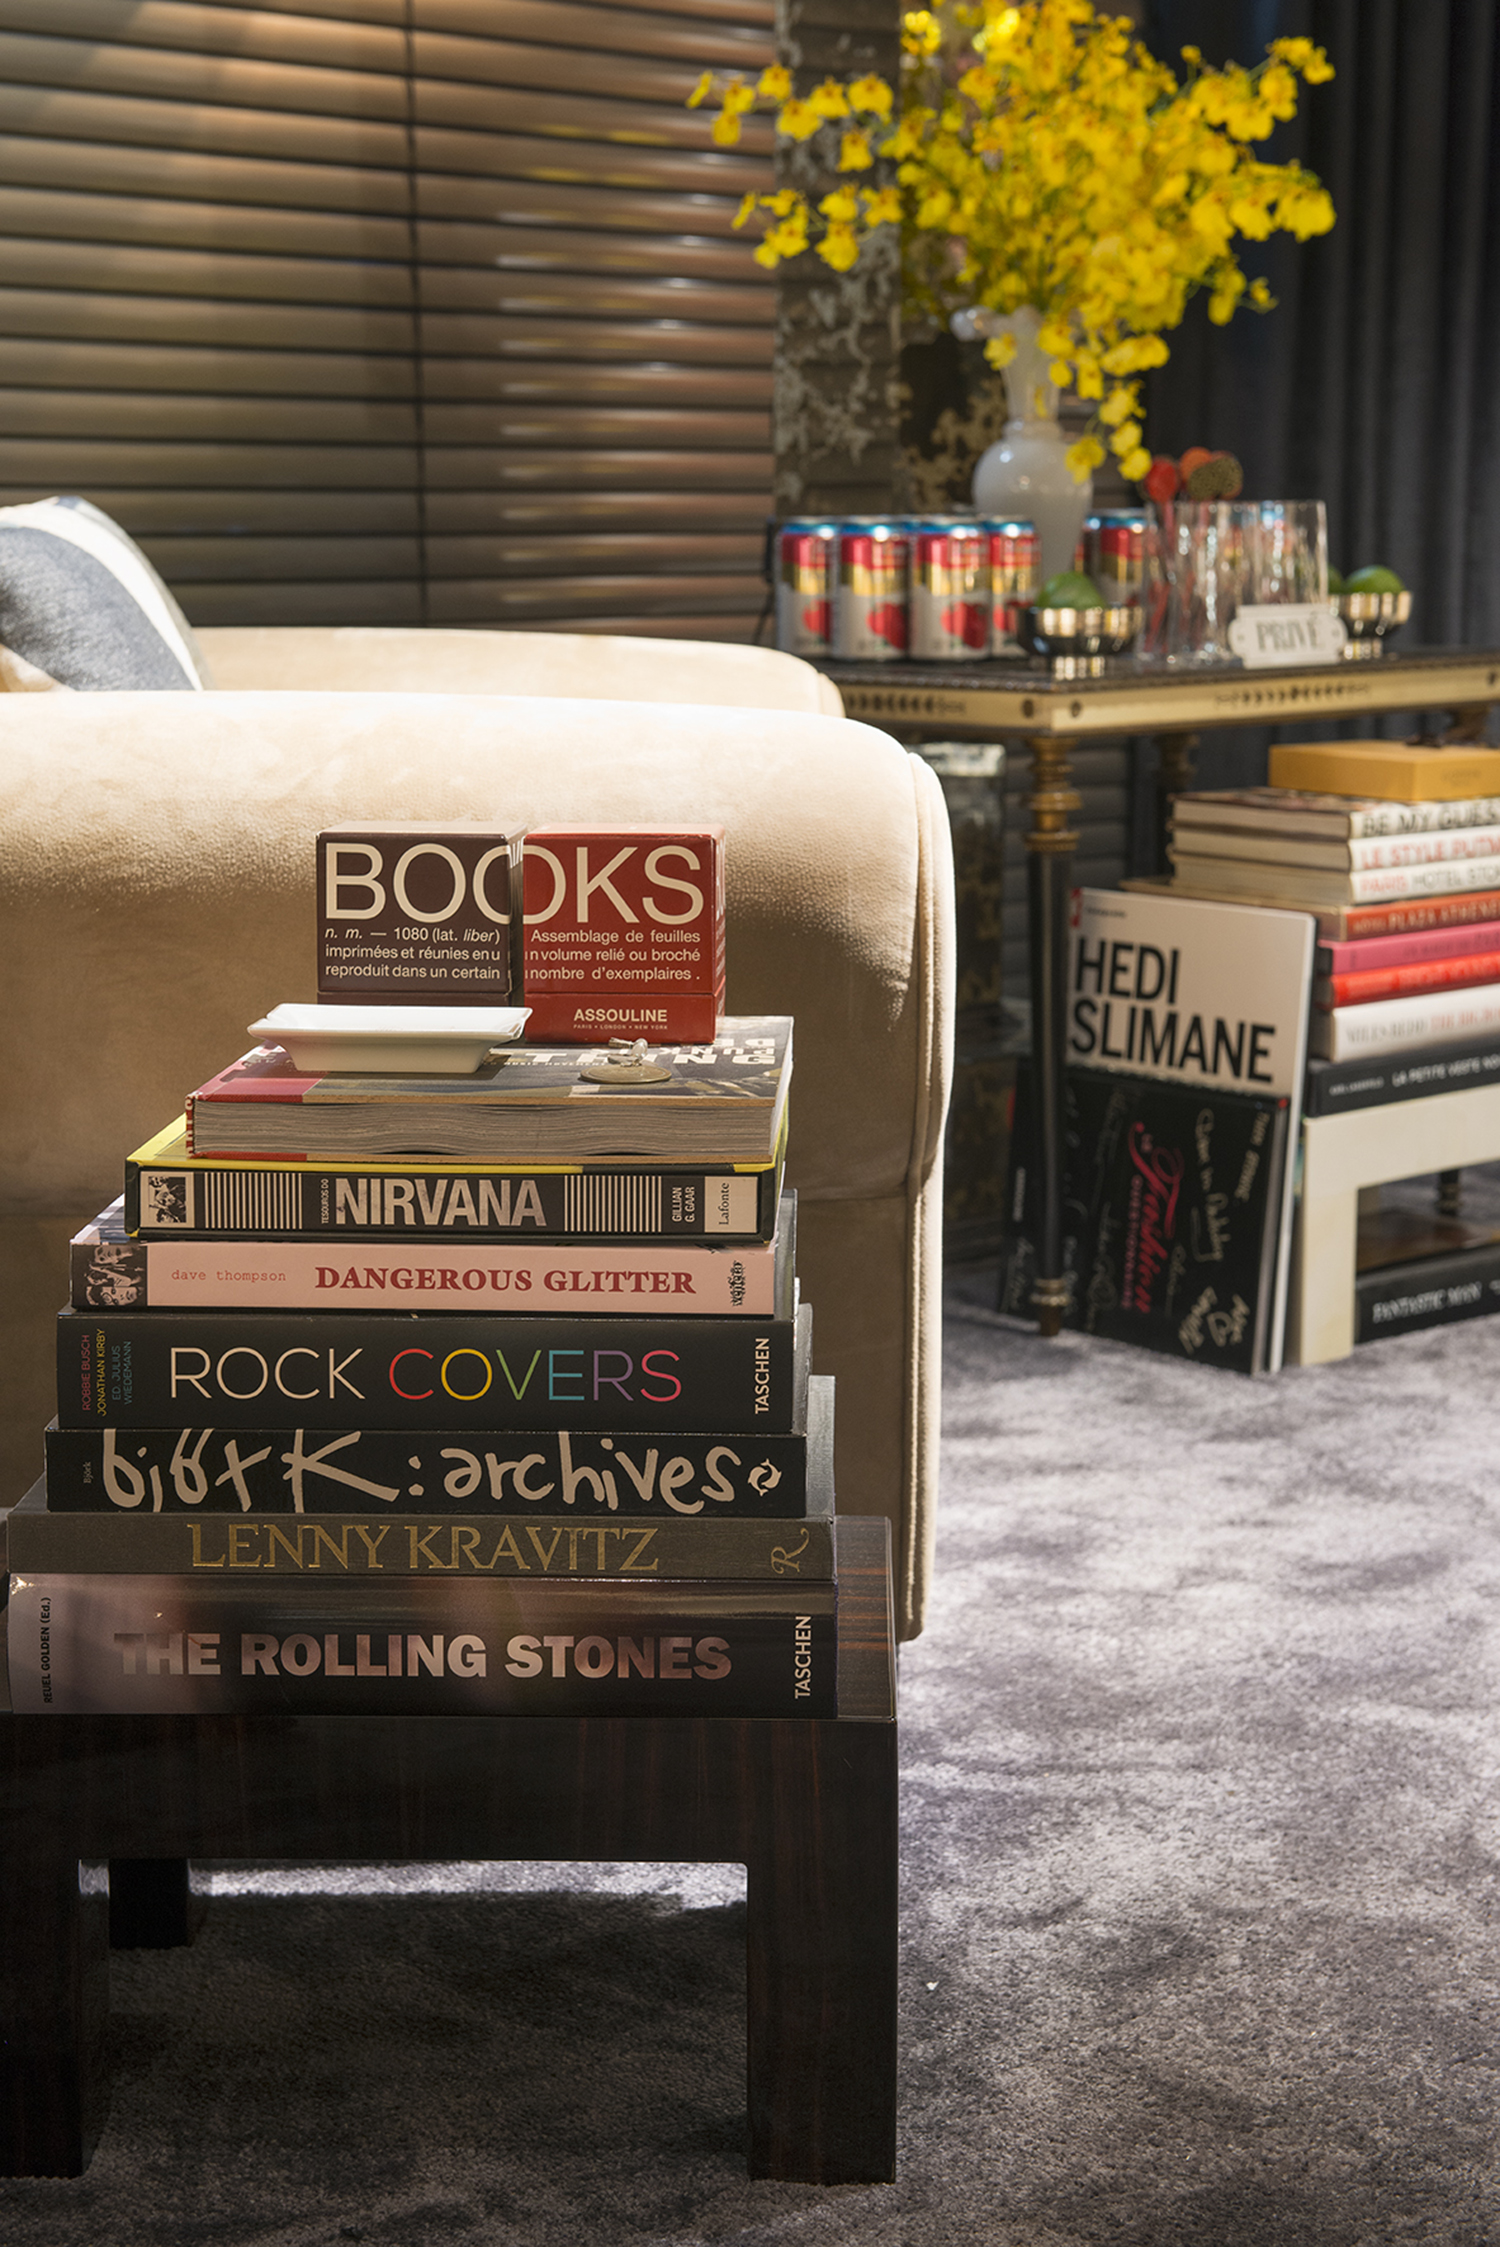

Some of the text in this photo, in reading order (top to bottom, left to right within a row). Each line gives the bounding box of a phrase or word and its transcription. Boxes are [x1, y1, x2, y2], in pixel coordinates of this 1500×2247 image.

[325, 944, 398, 960] imprimées
[401, 948, 415, 960] et
[419, 945, 470, 961] réunies
[394, 927, 429, 941] 1080
[432, 928, 458, 943] (lat.
[463, 928, 501, 945] liber)
[531, 929, 701, 945] Assemblage de feuilles
[543, 948, 592, 961] volume
[596, 948, 625, 961] relié
[629, 951, 647, 961] ou
[652, 948, 701, 962] broché
[325, 964, 501, 980] reproduit dans un certain
[530, 966, 585, 980] nombre
[1075, 936, 1181, 1005] HEDI
[573, 1009, 668, 1022] ASSOULINE
[1070, 996, 1276, 1084] SLIMANE
[321, 1178, 329, 1225] TESOUROS DO
[335, 1178, 547, 1226] NIRVANA
[671, 1186, 682, 1222] GILLIAN
[684, 1186, 695, 1213] GAAR
[717, 1182, 730, 1226] Lafonte
[171, 1269, 287, 1283] dave thompson
[315, 1266, 697, 1294] DANGEROUS GLITTER
[81, 1334, 91, 1411] ROBBIE BUSCH
[96, 1328, 107, 1417] JONATHAN KIRBY
[111, 1344, 121, 1401] ED. JULIUS
[123, 1340, 132, 1405] WIEDEMANN
[171, 1347, 682, 1402] ROCK COVERS
[755, 1337, 770, 1415] TASCHEN
[440, 1430, 742, 1514] archives
[187, 1523, 659, 1572] LENNY KRAVITZ
[40, 1597, 53, 1704] REUEL GOLDEN (Ed.)
[113, 1633, 732, 1681] THE ROLLING STONES
[795, 1615, 812, 1699] TASCHEN
